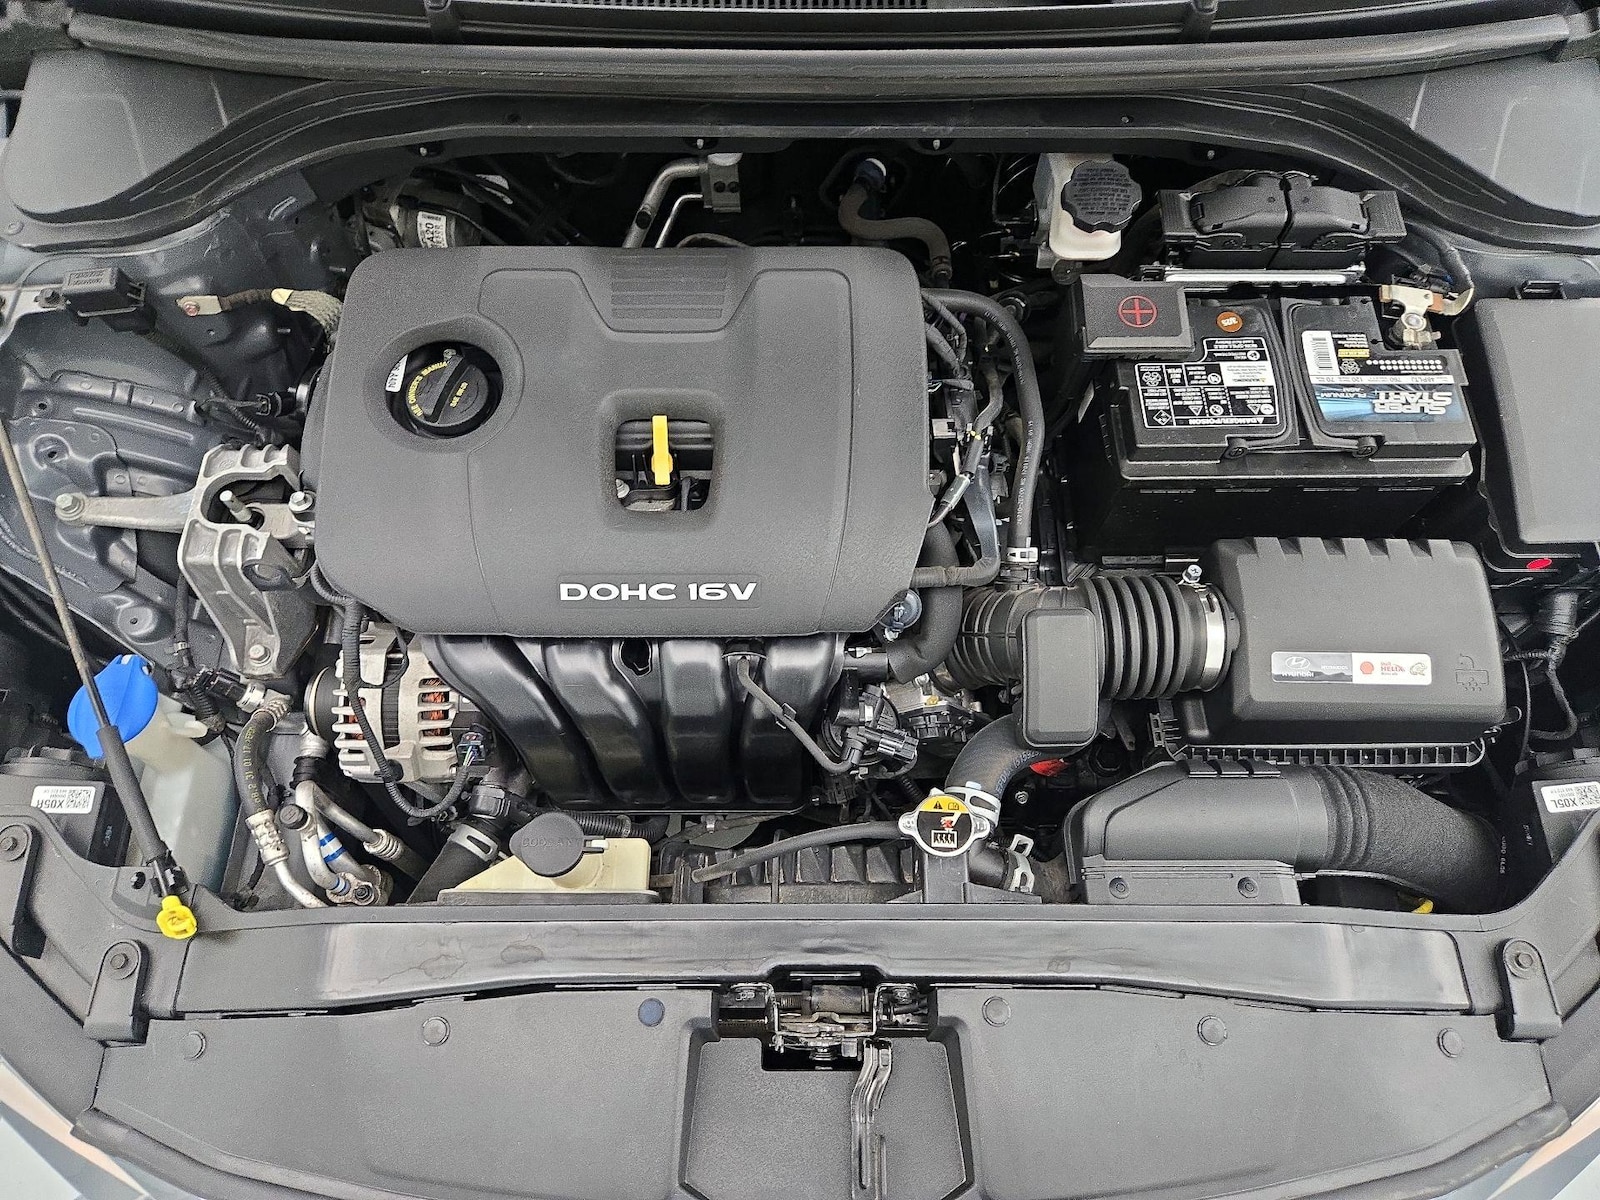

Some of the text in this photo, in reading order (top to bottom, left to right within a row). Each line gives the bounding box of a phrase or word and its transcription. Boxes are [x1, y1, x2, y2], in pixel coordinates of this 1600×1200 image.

[1372, 391, 1453, 405] START
[1374, 401, 1446, 415] SUPER
[560, 583, 757, 601] DOHC 16V
[1550, 797, 1578, 808] X05L
